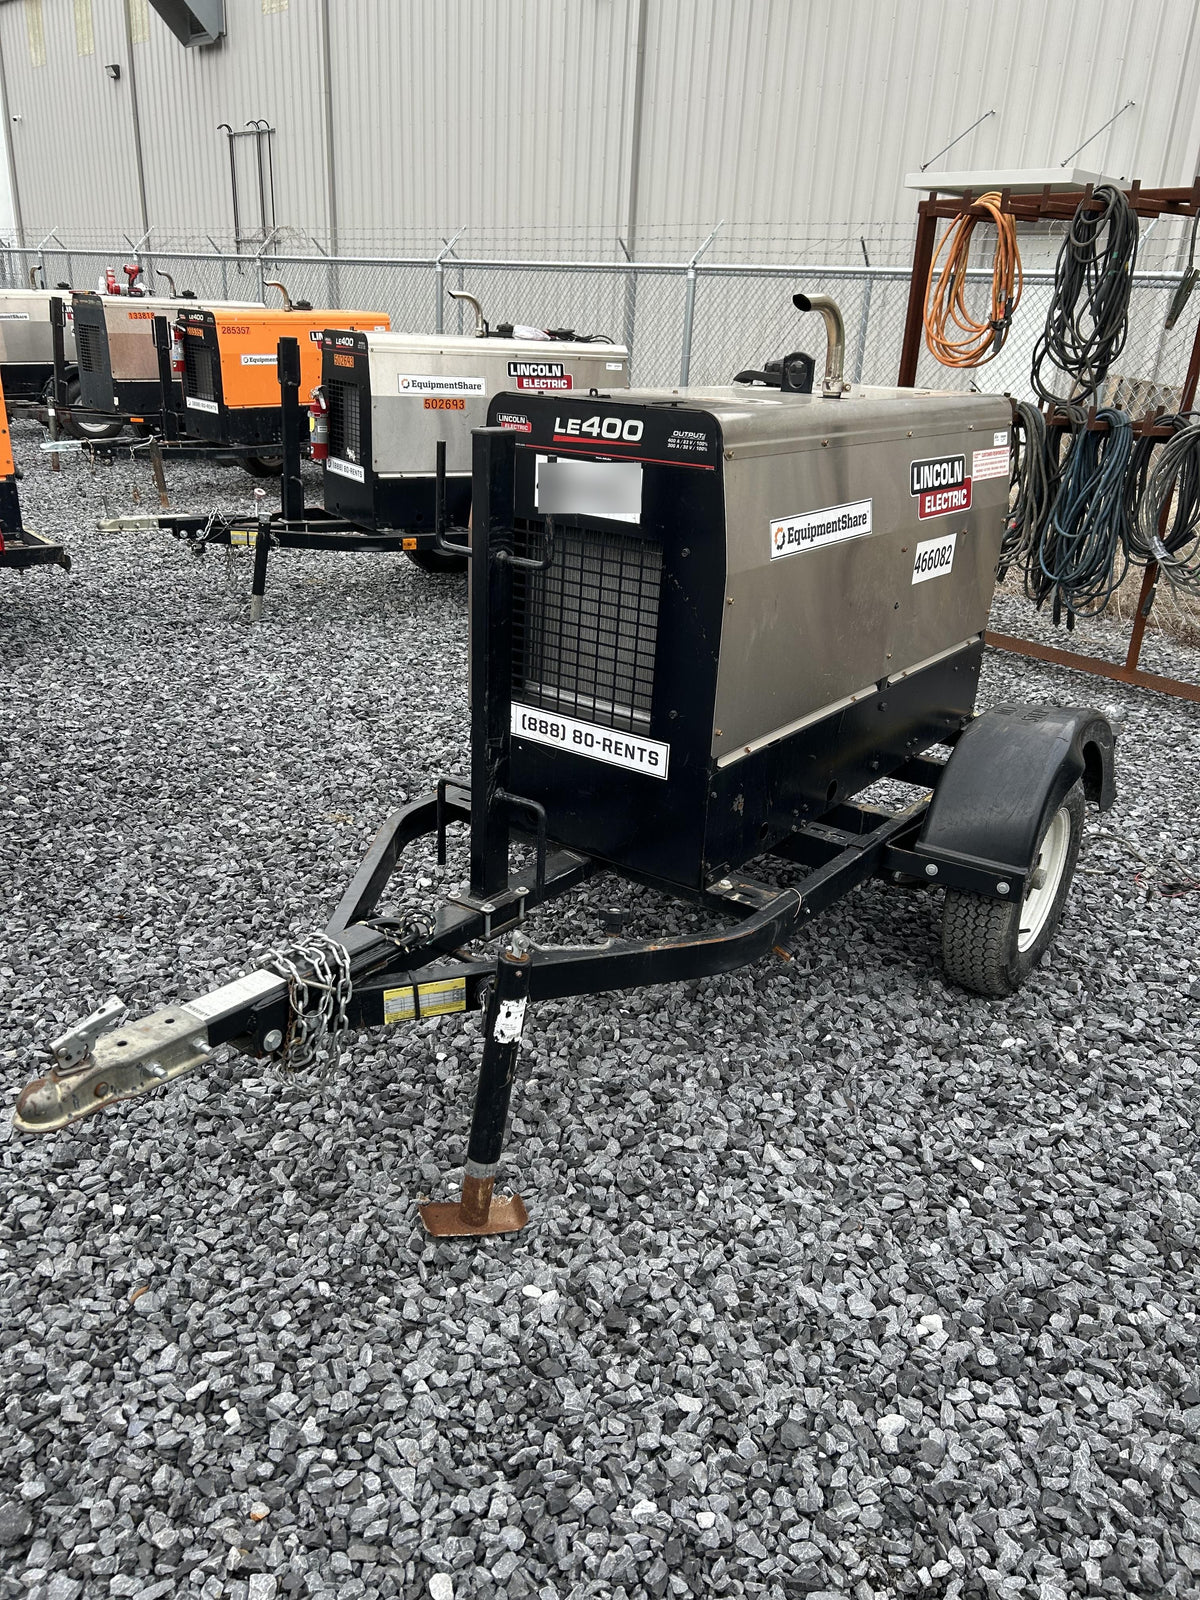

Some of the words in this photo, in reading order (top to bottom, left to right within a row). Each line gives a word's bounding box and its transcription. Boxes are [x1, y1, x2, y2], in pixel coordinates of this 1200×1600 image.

[222, 326, 250, 335] 285357
[336, 336, 354, 347] LE400
[510, 363, 562, 378] LINCOLN
[411, 380, 482, 393] EquipmentShare
[522, 379, 569, 389] ELECTRIC
[424, 399, 466, 409] 502693
[498, 414, 526, 424] LINCOLN
[553, 416, 645, 441] LE400
[913, 460, 963, 491] LINCOLN
[924, 489, 968, 513] ELECTRIC
[787, 512, 868, 546] EquipmentShare
[914, 544, 953, 574] 466082
[521, 713, 566, 741] (888)
[572, 729, 660, 767] 80-RENTS
